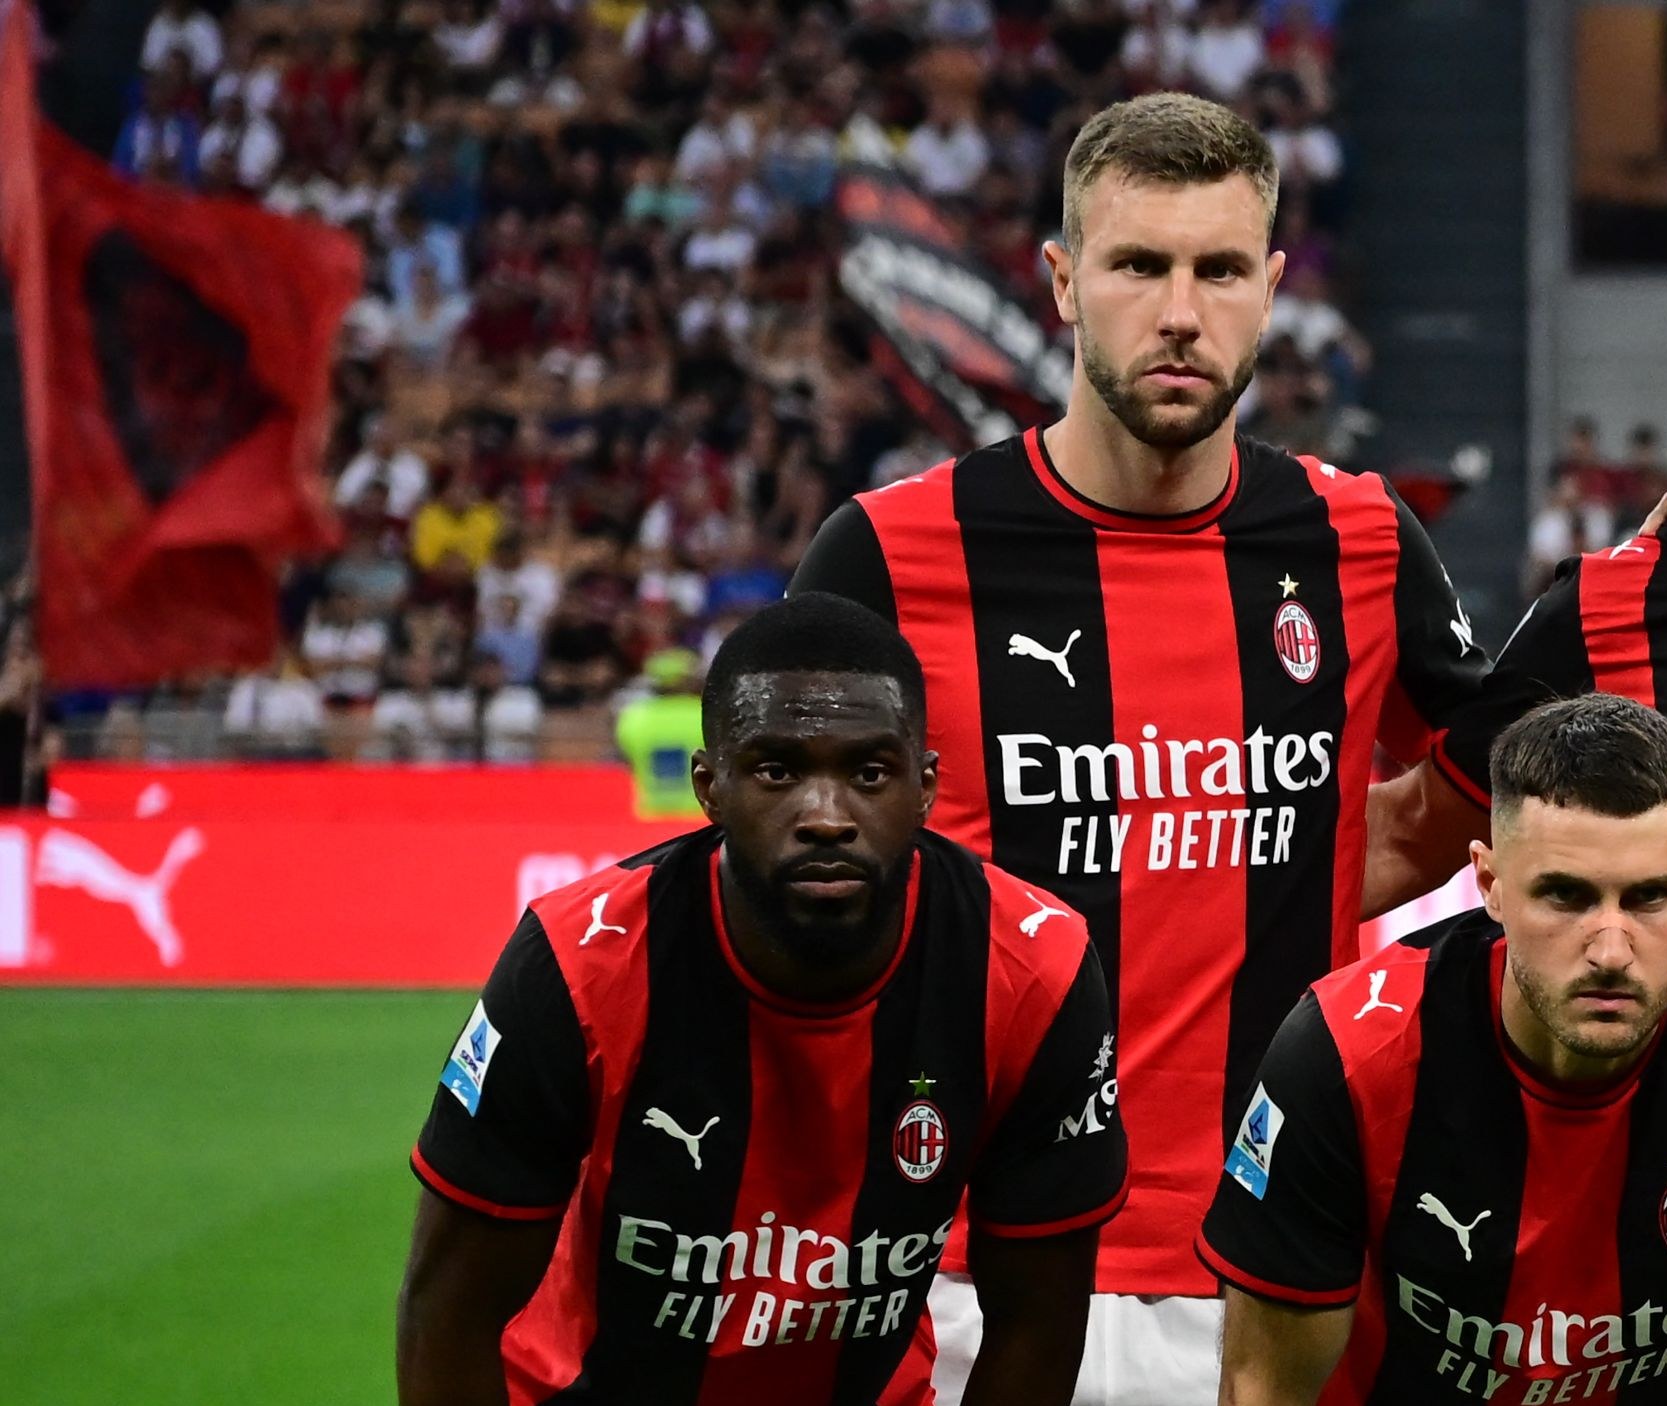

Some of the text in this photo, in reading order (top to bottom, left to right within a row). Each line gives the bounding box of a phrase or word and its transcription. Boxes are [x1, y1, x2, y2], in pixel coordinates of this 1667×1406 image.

[1281, 607, 1306, 622] ACM
[1290, 664, 1312, 674] 1899
[997, 724, 1333, 805] Emirates
[1058, 806, 1296, 875] FLY BETTER
[906, 1108, 937, 1123] ACM
[907, 1164, 933, 1175] 1899
[615, 1211, 954, 1290] Emirates
[654, 1289, 910, 1348] FLY BETTER
[1437, 1355, 1508, 1403] FLY
